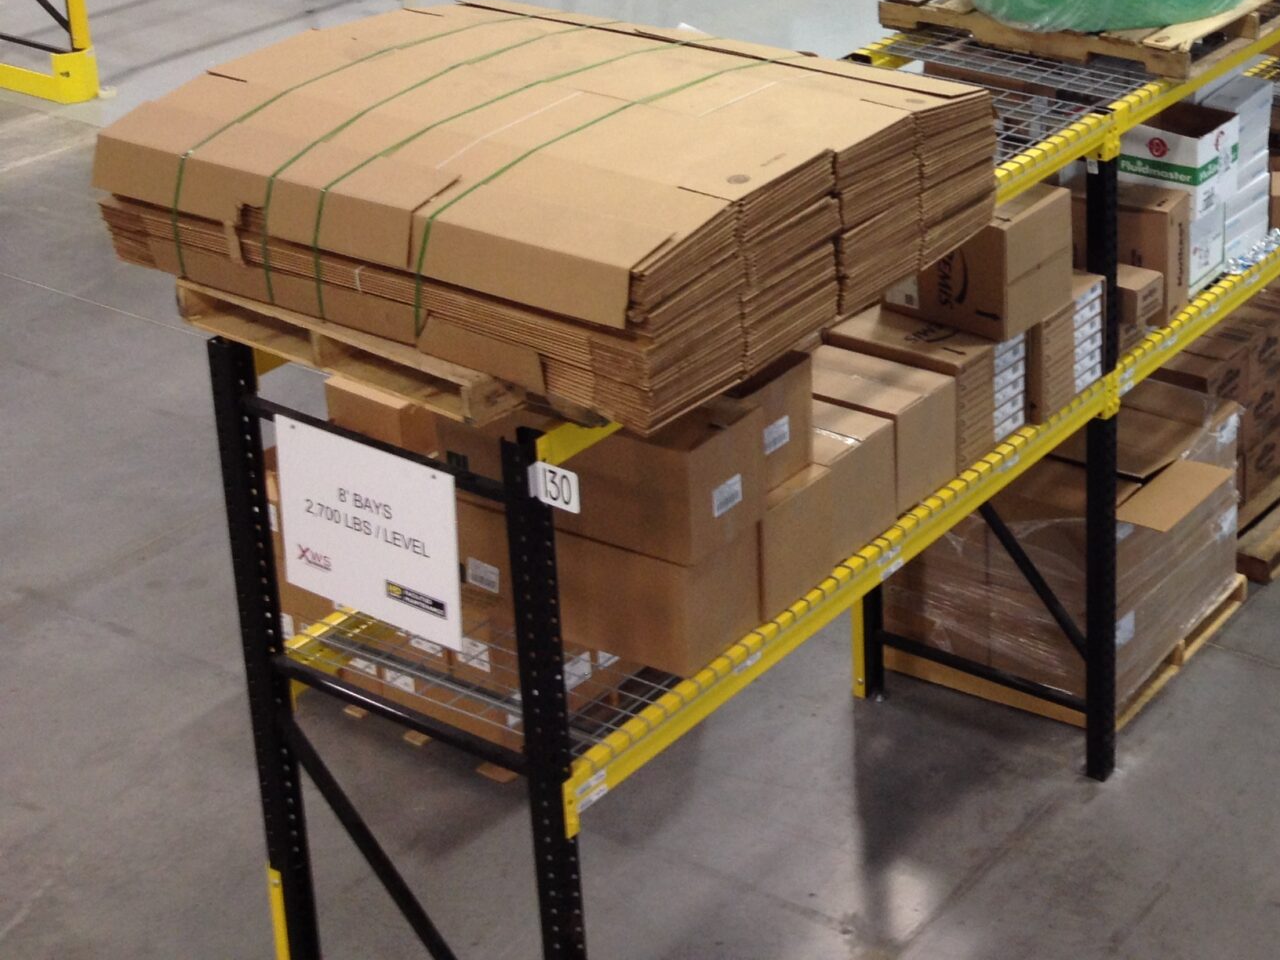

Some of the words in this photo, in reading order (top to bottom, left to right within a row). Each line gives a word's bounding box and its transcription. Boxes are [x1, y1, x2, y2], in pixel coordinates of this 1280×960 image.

[1120, 159, 1193, 183] Fluidmaster
[337, 487, 349, 503] 8'
[352, 492, 393, 521] BAYS
[543, 467, 572, 506] 130
[304, 498, 342, 525] 2,700
[344, 513, 373, 536] LBS
[383, 527, 431, 559] LEVEL
